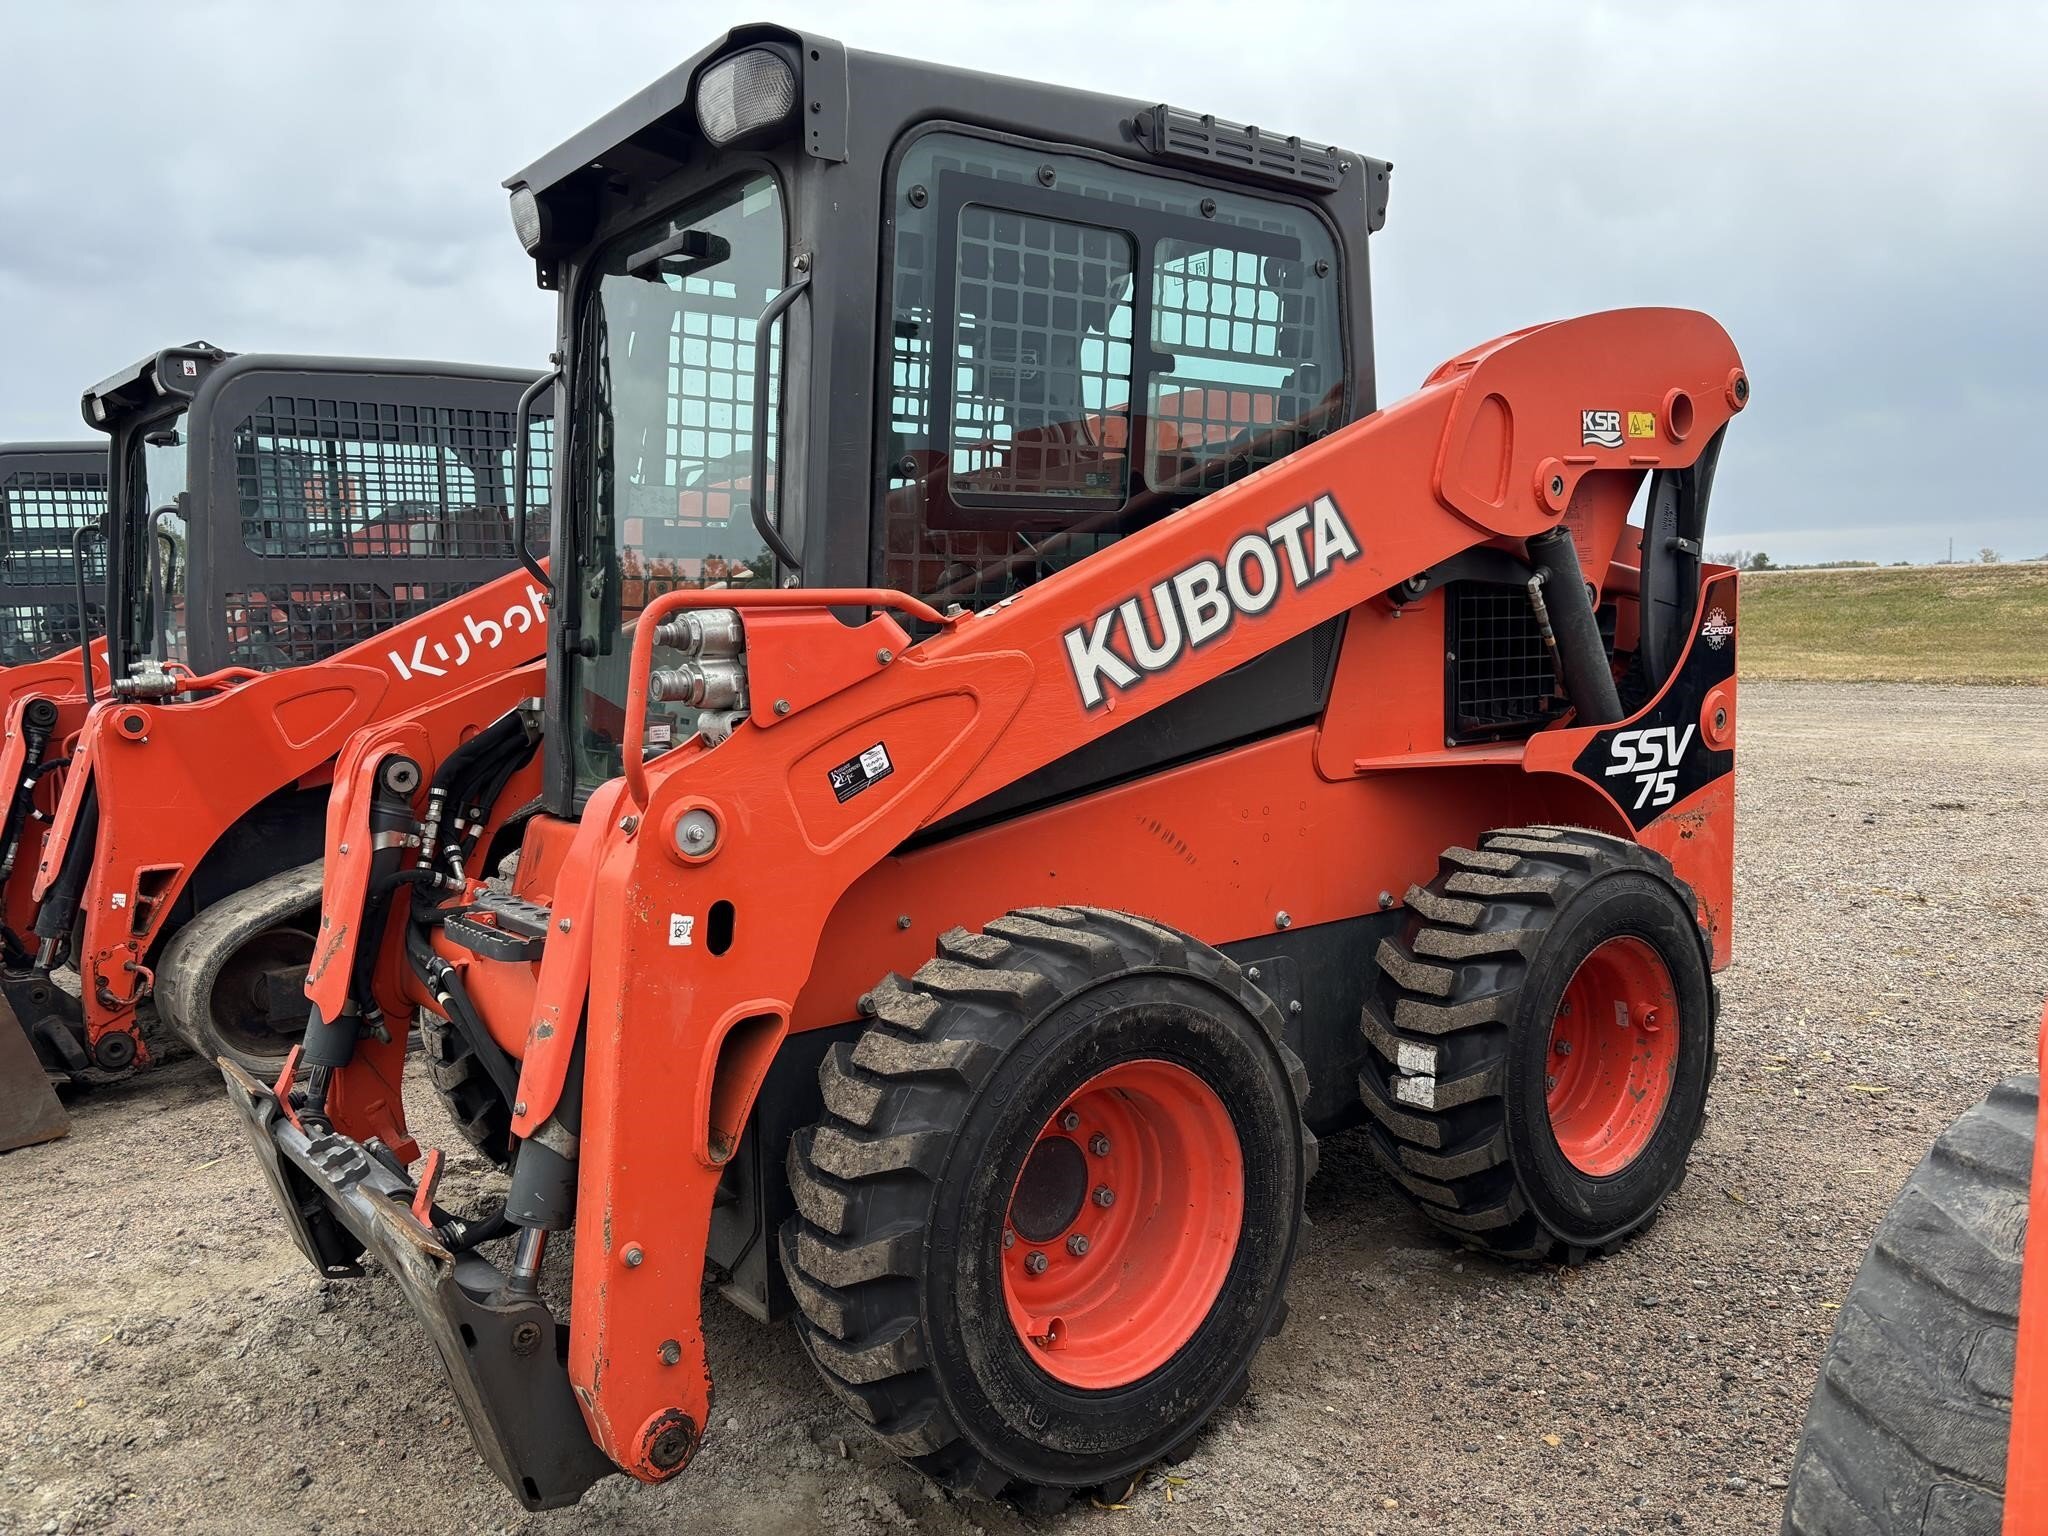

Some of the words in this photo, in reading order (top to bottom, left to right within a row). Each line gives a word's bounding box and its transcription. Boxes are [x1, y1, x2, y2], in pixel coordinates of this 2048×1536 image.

[1582, 410, 1620, 431] KSR
[387, 584, 545, 681] Kubot
[1063, 494, 1361, 709] KUBOTA
[1605, 723, 1697, 776] SSV
[1633, 769, 1678, 810] 75
[990, 988, 1127, 1107] GALAXY
